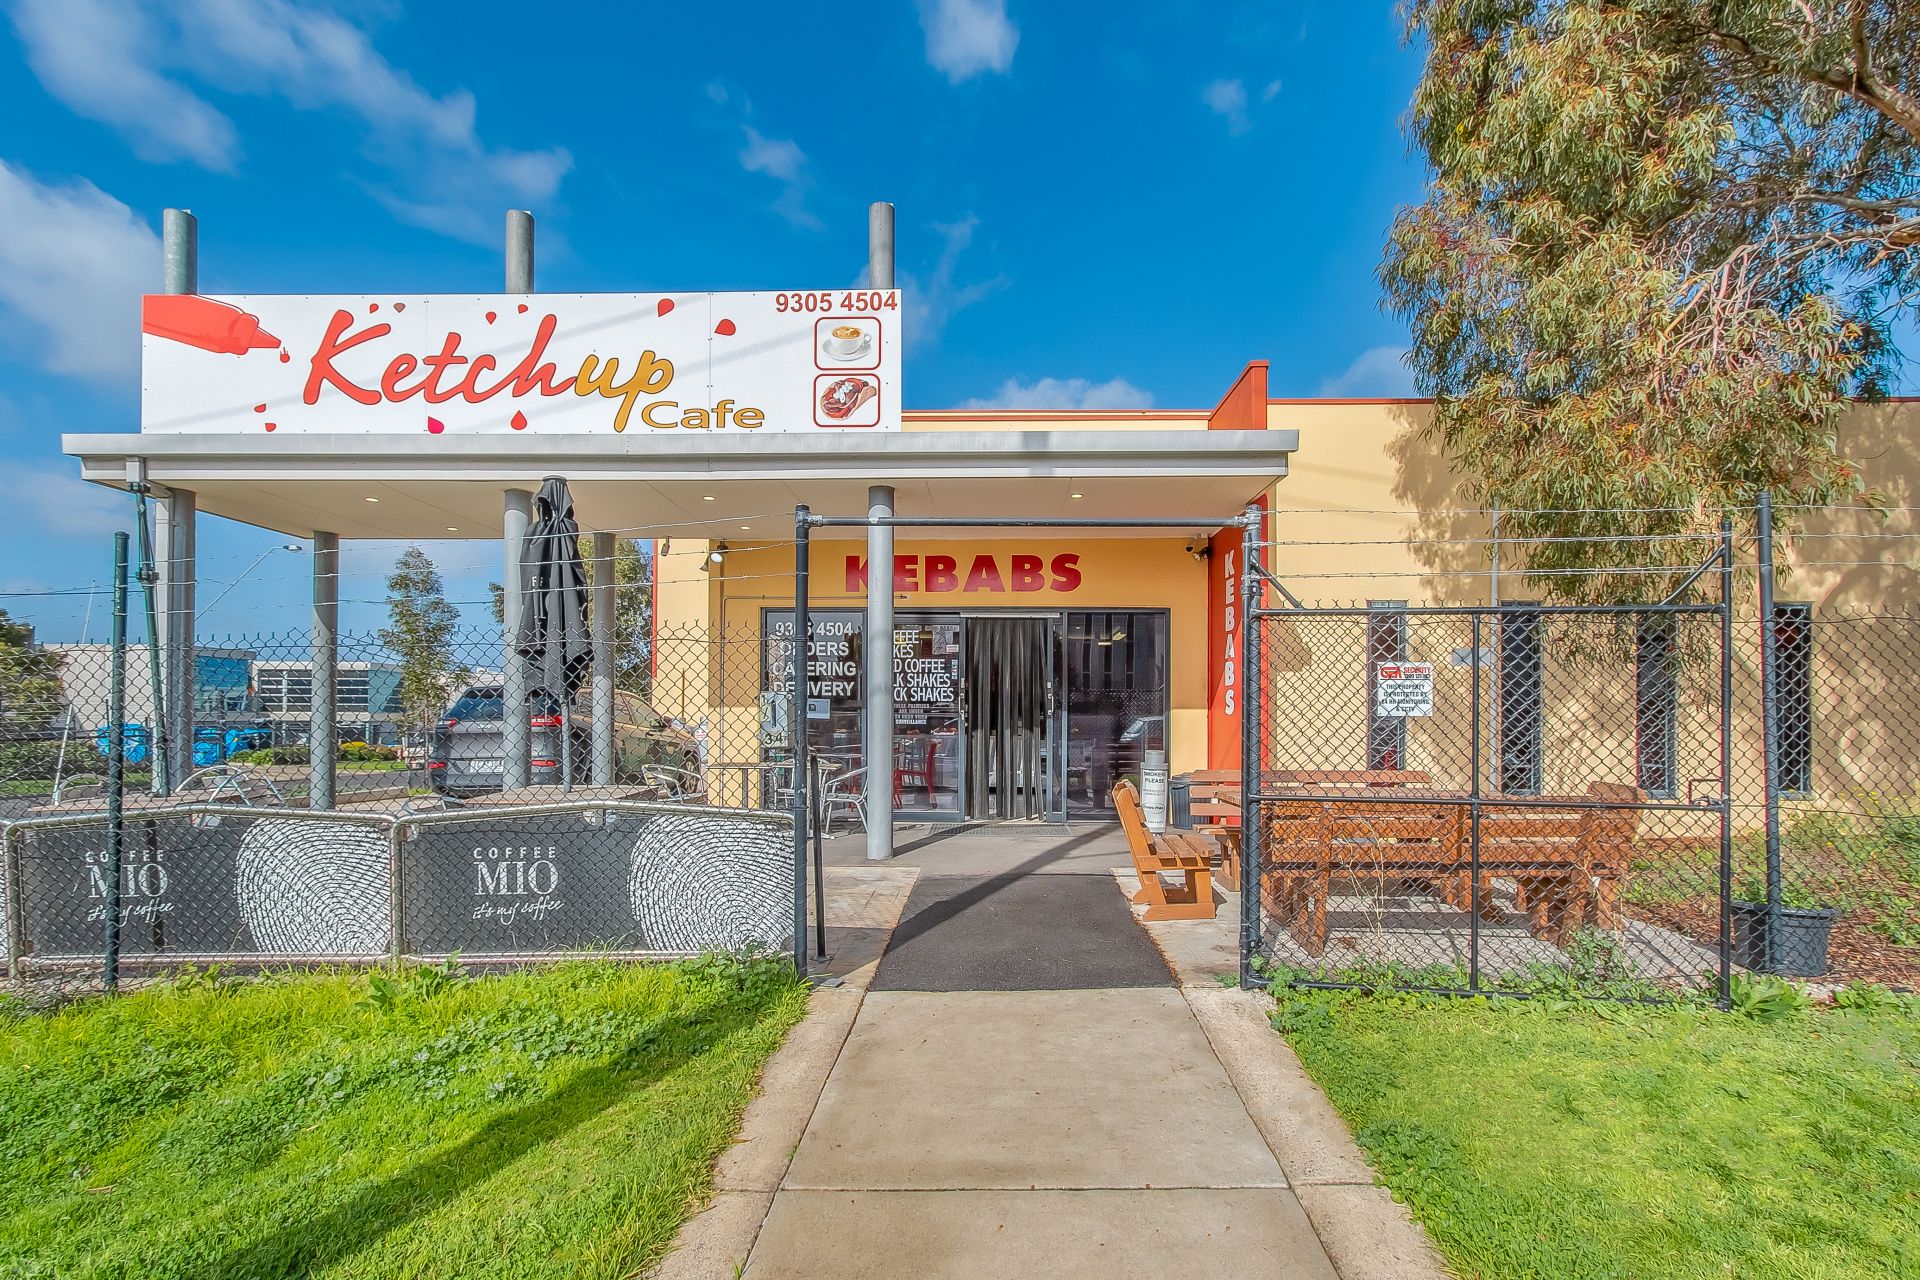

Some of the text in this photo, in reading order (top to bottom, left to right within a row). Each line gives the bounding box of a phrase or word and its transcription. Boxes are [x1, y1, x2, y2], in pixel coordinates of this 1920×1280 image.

[775, 291, 898, 313] 9305 4504
[302, 308, 675, 433] Ketchup
[641, 399, 766, 429] Cafe
[845, 553, 1082, 593] KEBABS
[775, 621, 854, 636] 935 4504
[1224, 549, 1236, 716] KEBABS
[780, 641, 849, 656] ODERS
[772, 661, 857, 676] CAERING
[904, 659, 945, 673] COFFEE
[906, 673, 951, 687] SHAKES
[773, 681, 855, 697] DEIVERY
[910, 687, 954, 702] SHAKES
[85, 849, 165, 863] COFEE
[473, 846, 557, 860] COFFEE
[473, 860, 560, 896] MIO
[521, 895, 567, 921] coffee
